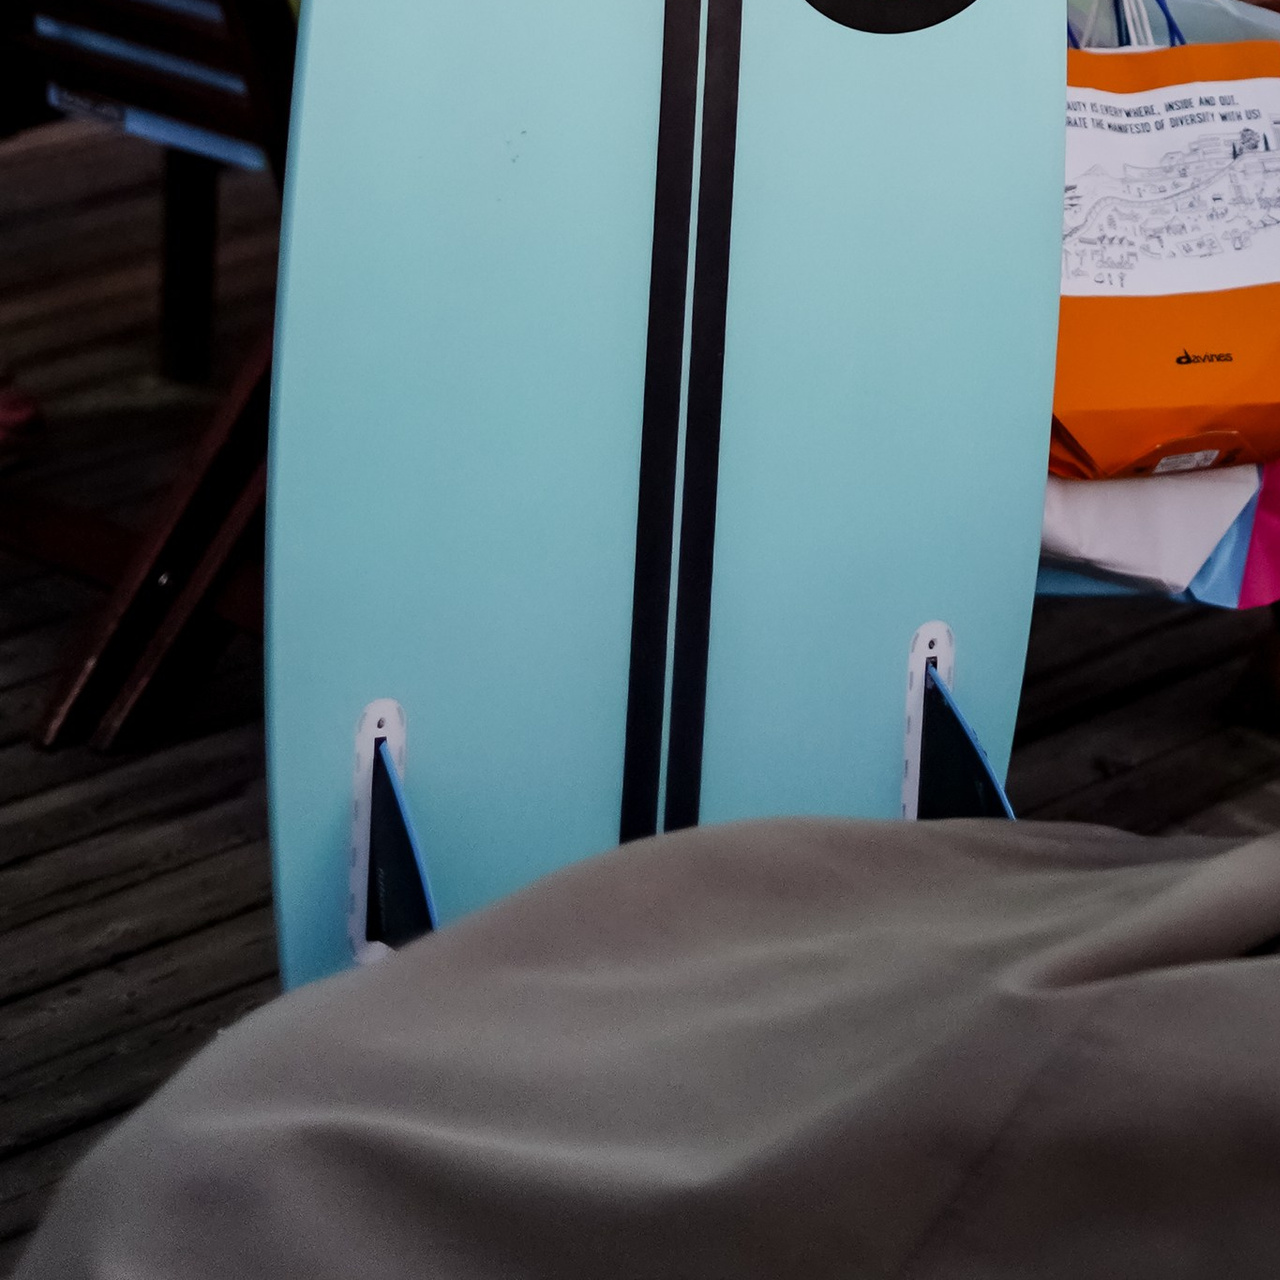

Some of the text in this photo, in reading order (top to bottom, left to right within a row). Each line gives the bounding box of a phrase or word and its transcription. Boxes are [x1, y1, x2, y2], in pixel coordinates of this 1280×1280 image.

[1090, 102, 1098, 114] IS
[1164, 98, 1194, 112] INSIDE
[1199, 96, 1216, 106] AND
[1091, 117, 1105, 130] THE
[1107, 121, 1151, 134] MANIFESTO
[1154, 119, 1165, 131] OF
[1169, 111, 1215, 128] DIVERSITY
[1219, 111, 1243, 122] WITH
[1175, 347, 1234, 365] davines
